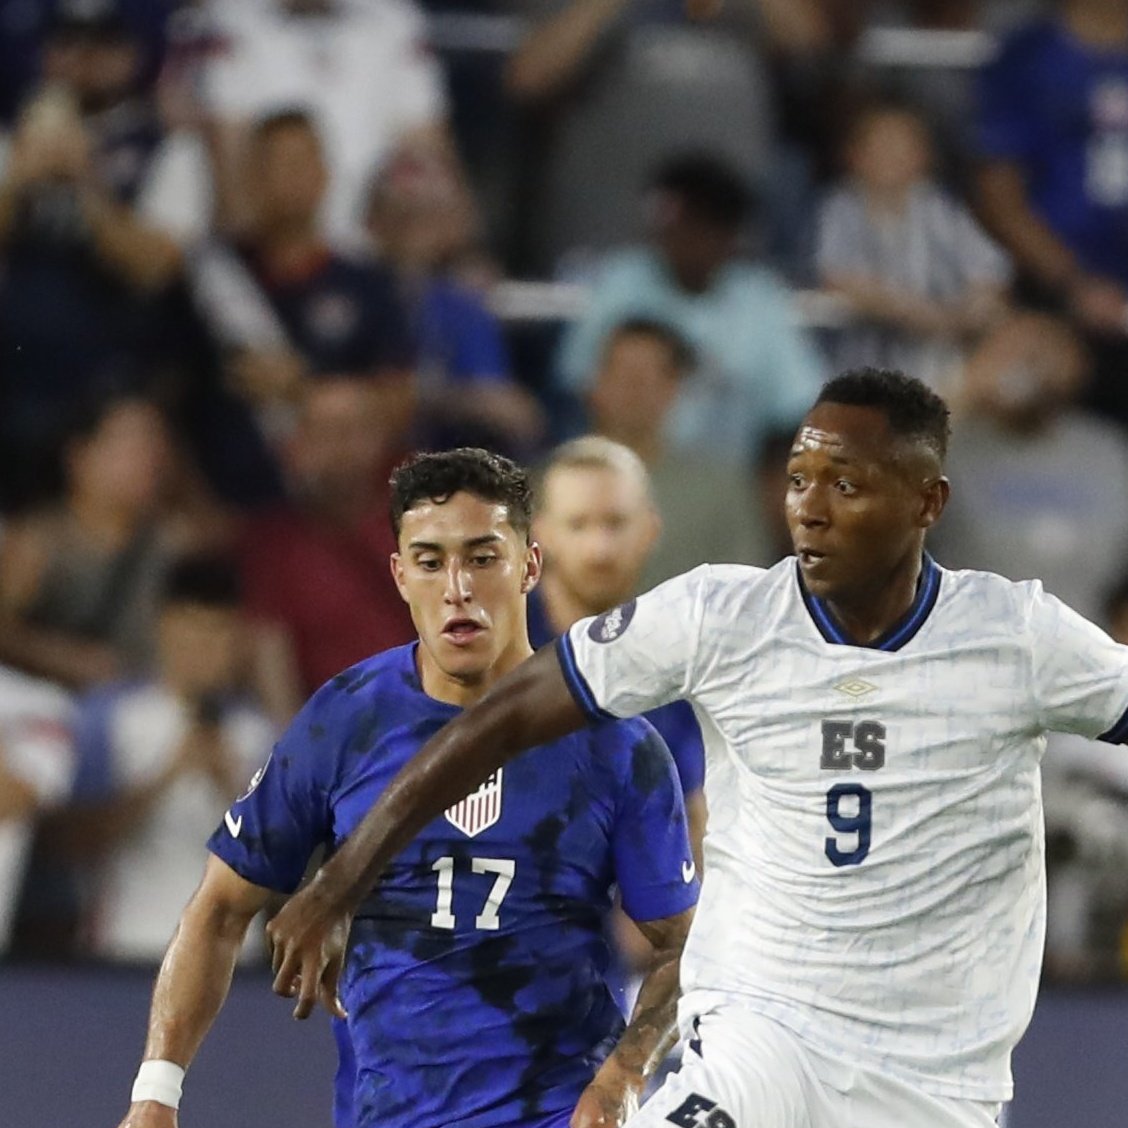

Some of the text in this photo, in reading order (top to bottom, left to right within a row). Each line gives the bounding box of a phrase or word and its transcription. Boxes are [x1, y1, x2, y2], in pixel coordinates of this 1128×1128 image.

[820, 719, 886, 770] ES
[825, 783, 872, 867] 9
[431, 857, 515, 930] 17
